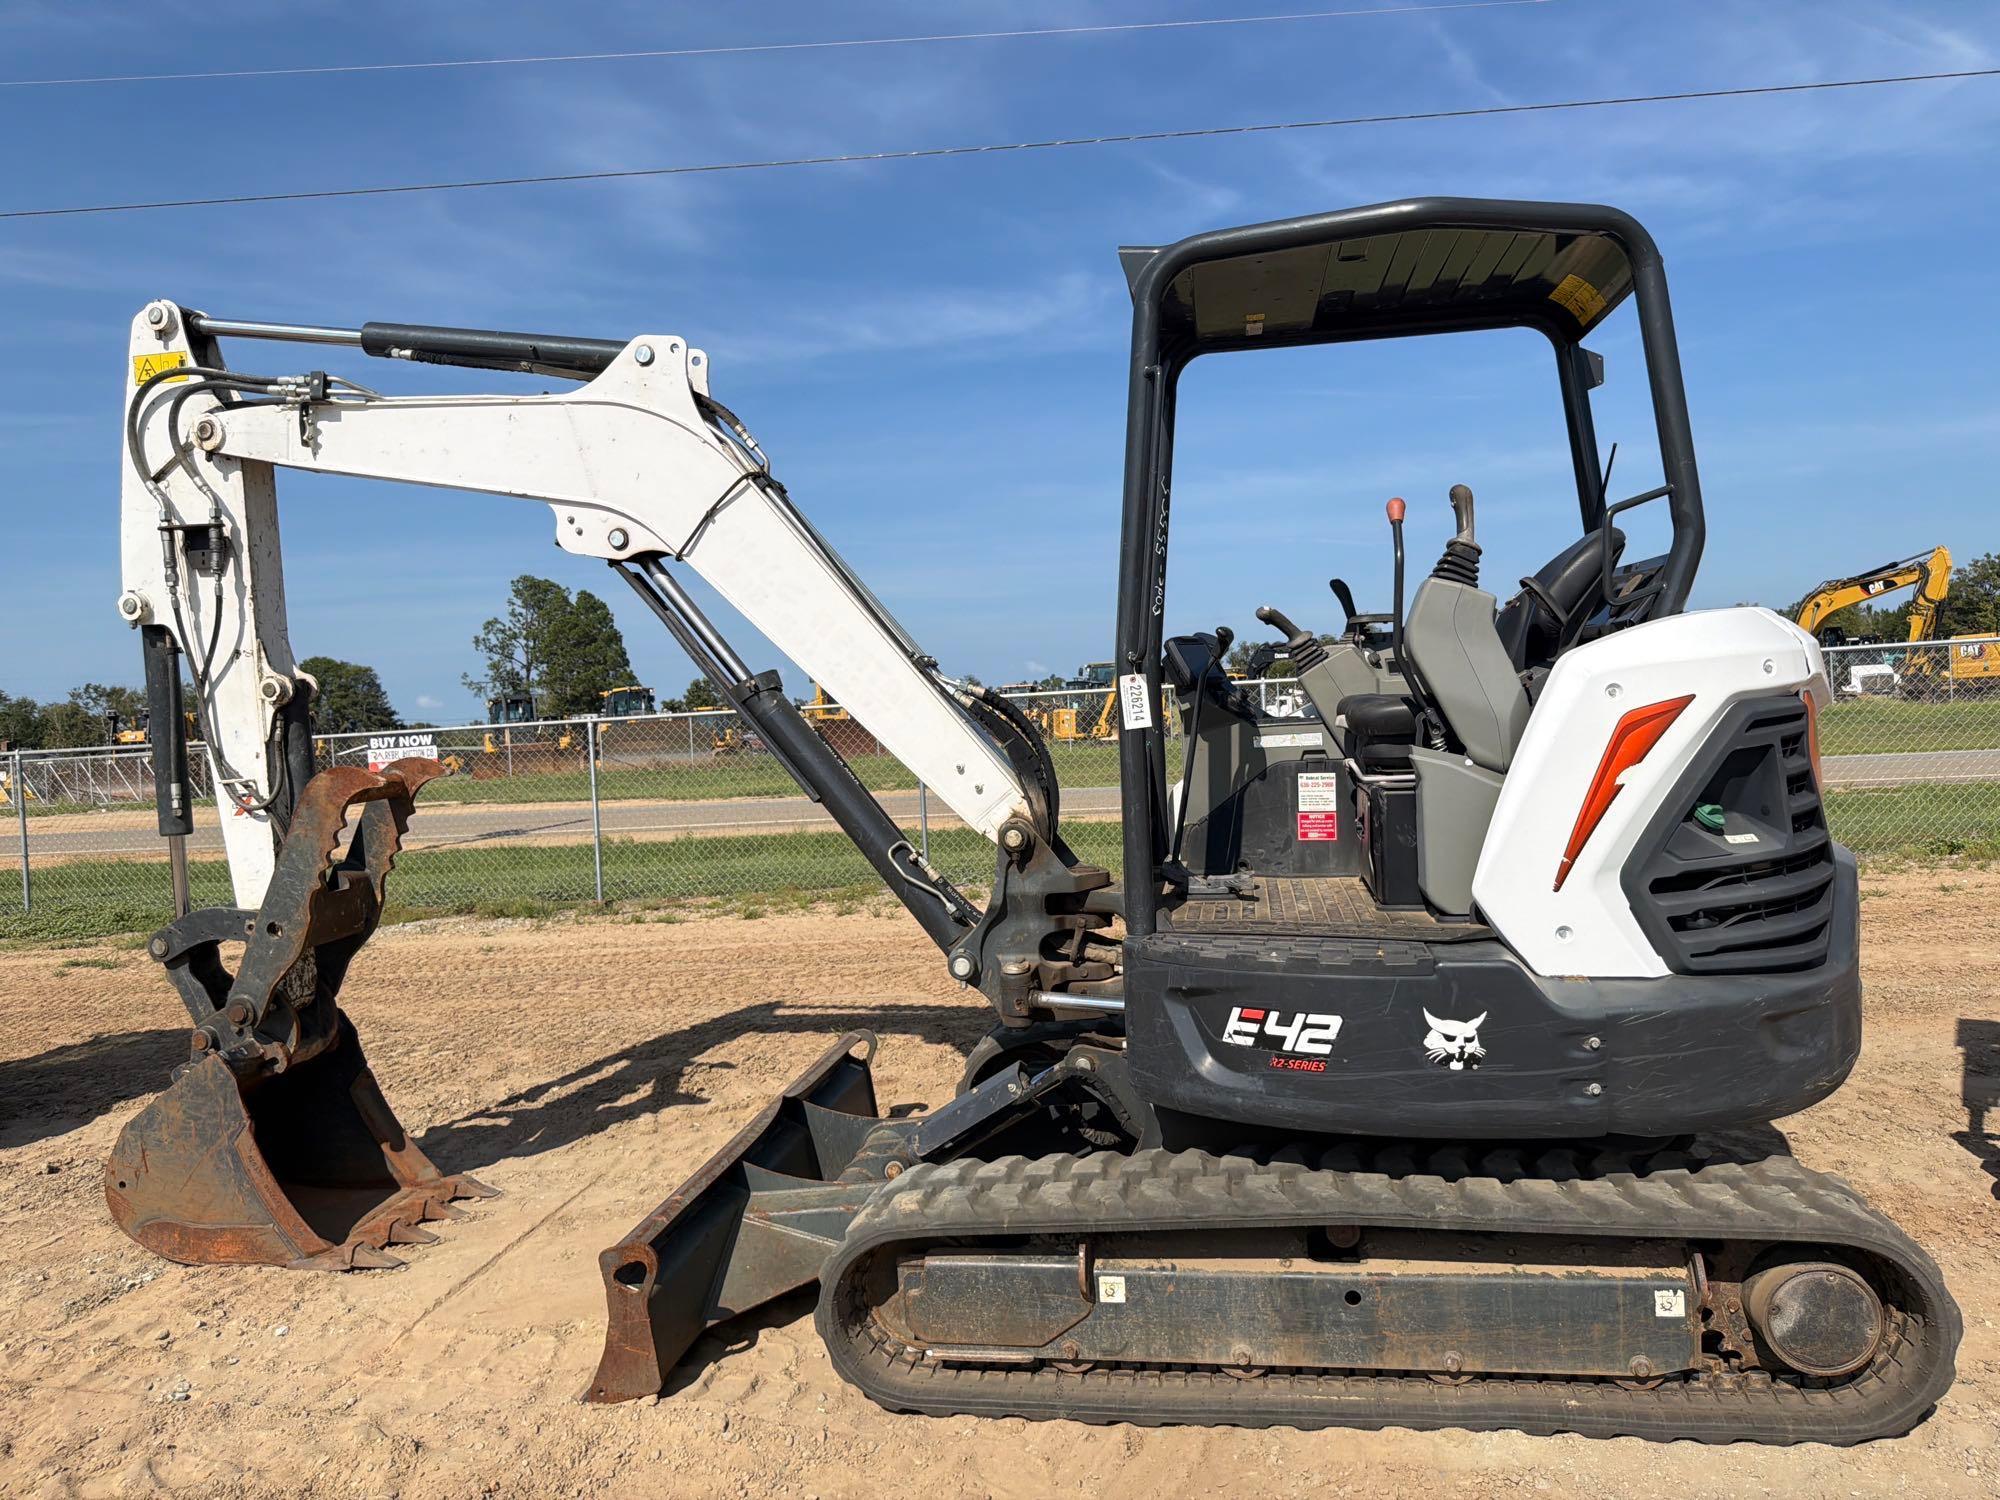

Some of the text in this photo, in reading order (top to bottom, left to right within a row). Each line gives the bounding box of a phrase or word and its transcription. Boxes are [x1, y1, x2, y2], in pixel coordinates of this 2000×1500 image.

[1868, 580, 1885, 595] CAT
[1960, 644, 1980, 657] CAT
[1129, 684, 1145, 722] 226214
[370, 734, 433, 749] BUY NOW
[1222, 1006, 1344, 1055] E42
[1270, 1056, 1327, 1073] R2-SERIES
